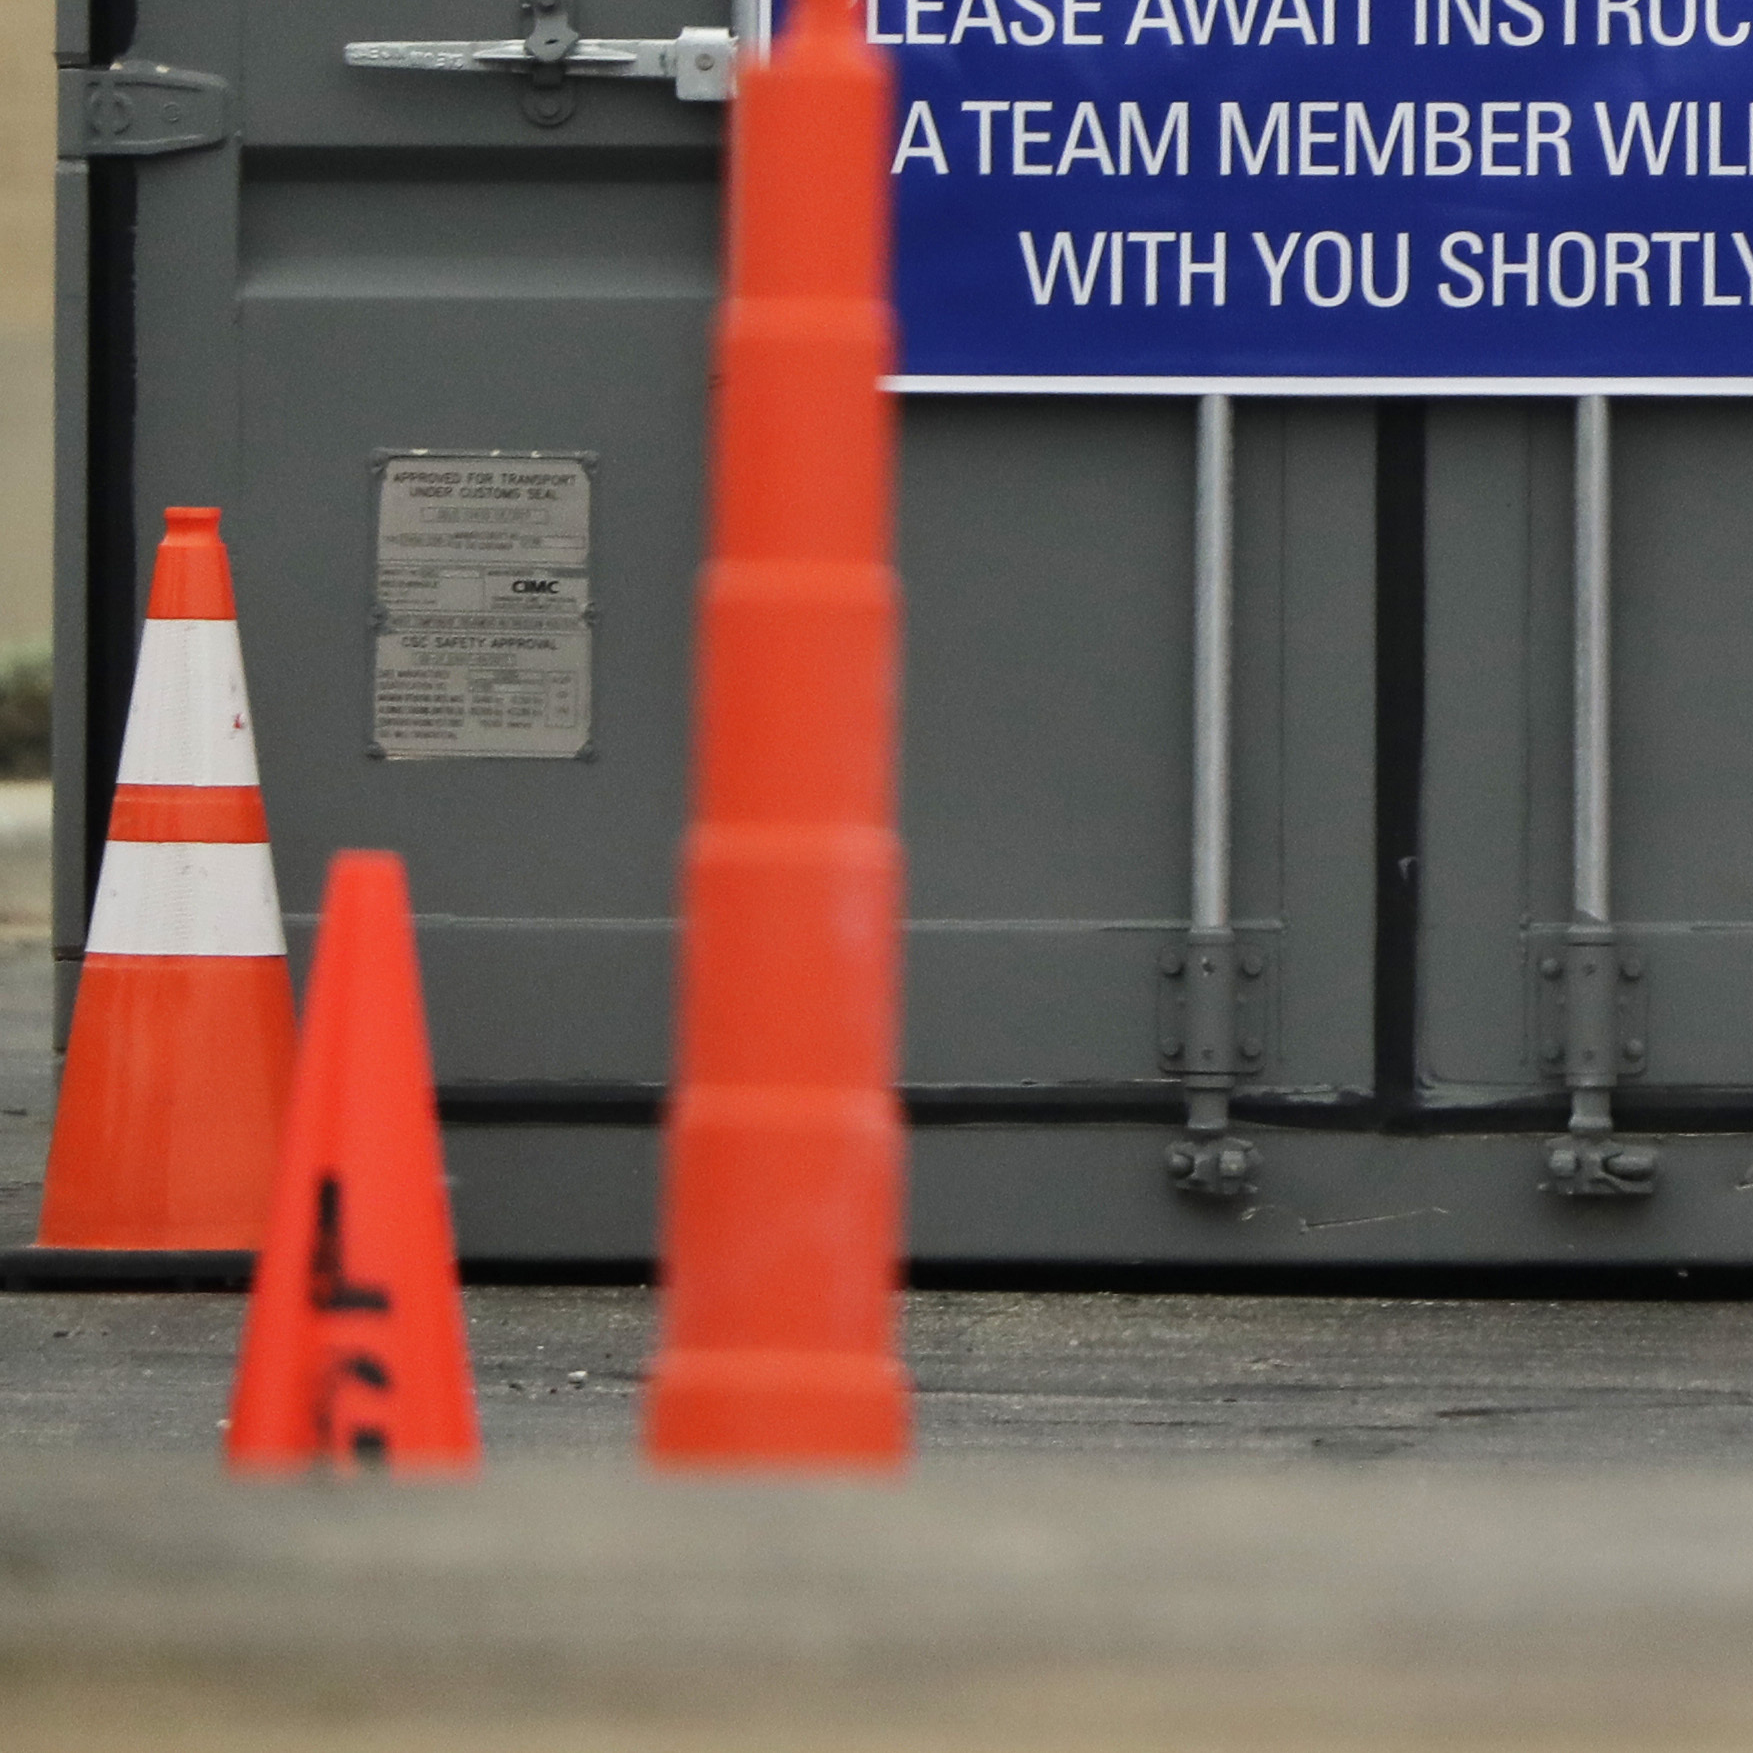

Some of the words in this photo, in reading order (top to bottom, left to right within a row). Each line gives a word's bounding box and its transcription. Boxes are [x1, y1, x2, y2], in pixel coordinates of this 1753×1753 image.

[890, 100, 950, 175] A
[960, 100, 1190, 176] TEAM
[1218, 101, 1573, 176] MEMBER
[1018, 231, 1226, 306] WITH
[1252, 230, 1410, 308] YOU
[393, 471, 461, 484] APPROVED
[467, 472, 493, 484] FOR
[500, 472, 576, 486] TRANSPORT
[409, 485, 453, 498] UNDER
[458, 486, 522, 499] CUSTOMS
[526, 487, 558, 500] SEAL
[511, 579, 560, 594] CIMC
[434, 635, 487, 649] SAFETY
[490, 636, 558, 651] APPROVAL
